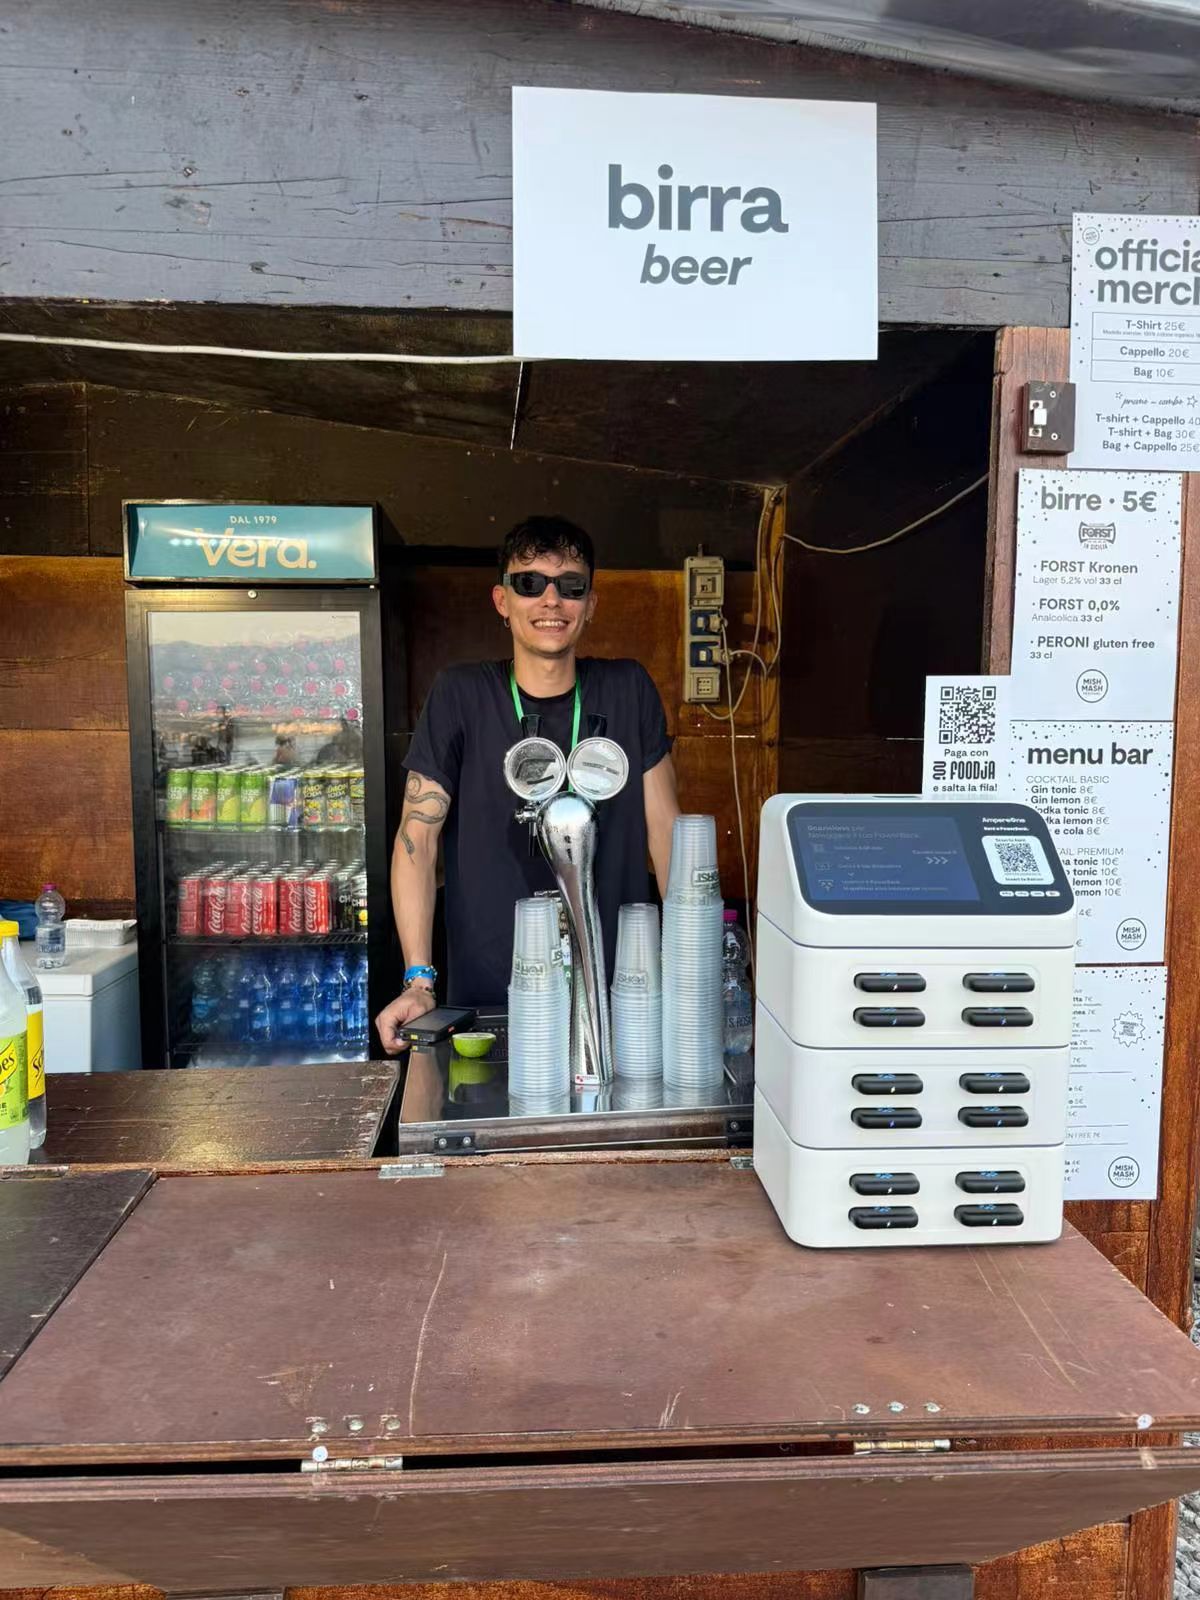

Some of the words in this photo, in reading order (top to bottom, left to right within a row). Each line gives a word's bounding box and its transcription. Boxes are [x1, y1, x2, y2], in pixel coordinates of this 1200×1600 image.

[608, 163, 789, 234] birra
[640, 243, 752, 286] beer
[1126, 320, 1162, 331] T-Shirt
[1164, 321, 1186, 332] 25€
[1120, 346, 1166, 358] Cappello
[1168, 348, 1190, 358] 20€
[1133, 367, 1153, 379] Bag
[1156, 368, 1175, 378] 10€
[1096, 413, 1130, 423] T-shirt
[1142, 415, 1186, 427] Cappello
[1108, 427, 1142, 437] T-shirt
[1154, 429, 1172, 440] Bag
[1175, 430, 1196, 439] 30€
[1103, 440, 1121, 451] Bag
[1133, 442, 1178, 453] Cappello
[1041, 485, 1102, 511] birre
[1122, 490, 1158, 512] 5€
[229, 515, 251, 524] DAL
[254, 515, 277, 524] 1979
[1040, 560, 1085, 573] FORST
[1089, 561, 1138, 574] Kronen
[1033, 575, 1059, 586] Lager
[1083, 576, 1097, 585] vol
[1099, 577, 1111, 585] 33
[1113, 576, 1122, 585] cl
[1039, 598, 1084, 611] FORST
[1088, 600, 1120, 612] 0,0%
[1080, 614, 1093, 623] 33
[1095, 613, 1104, 623] cl
[1037, 635, 1090, 648] PERONI
[1093, 637, 1129, 652] gluten
[1132, 637, 1155, 650] free
[1030, 651, 1042, 660] 33
[1044, 650, 1053, 660] cl
[1081, 684, 1103, 692] MASH
[944, 748, 968, 759] Paga
[1027, 745, 1103, 765] menu
[1110, 742, 1154, 765] bar
[1026, 775, 1077, 784] COCKTAIL
[1080, 775, 1110, 784] BASIC
[941, 783, 966, 792] salta
[968, 783, 977, 792] la
[979, 783, 998, 792] fila!
[1031, 785, 1048, 794] Gin
[1051, 785, 1077, 794] tonic
[1079, 785, 1094, 795] 8€
[1031, 795, 1048, 804] Gin
[1051, 795, 1081, 804] lemon
[1083, 796, 1098, 805] 8€
[1035, 805, 1061, 815] odka
[1064, 805, 1089, 815] tonic
[1091, 806, 1106, 815] 8€
[1063, 815, 1093, 825] lemon
[1095, 816, 1110, 825] 8€
[1063, 826, 1084, 835] cola
[1086, 826, 1101, 836] 8€
[1058, 847, 1076, 856] AIL
[1077, 847, 1124, 856] PREMIUM
[1073, 857, 1098, 866] tonic
[1101, 857, 1120, 866] 10€
[1072, 867, 1098, 876] tonic
[1101, 867, 1119, 876] 10€
[1072, 877, 1102, 887] lemon
[1104, 878, 1123, 887] 10€
[1073, 888, 1101, 897] emon
[1104, 888, 1122, 897] 10€
[1122, 926, 1141, 934] MISH
[1112, 1170, 1135, 1178] MASH
